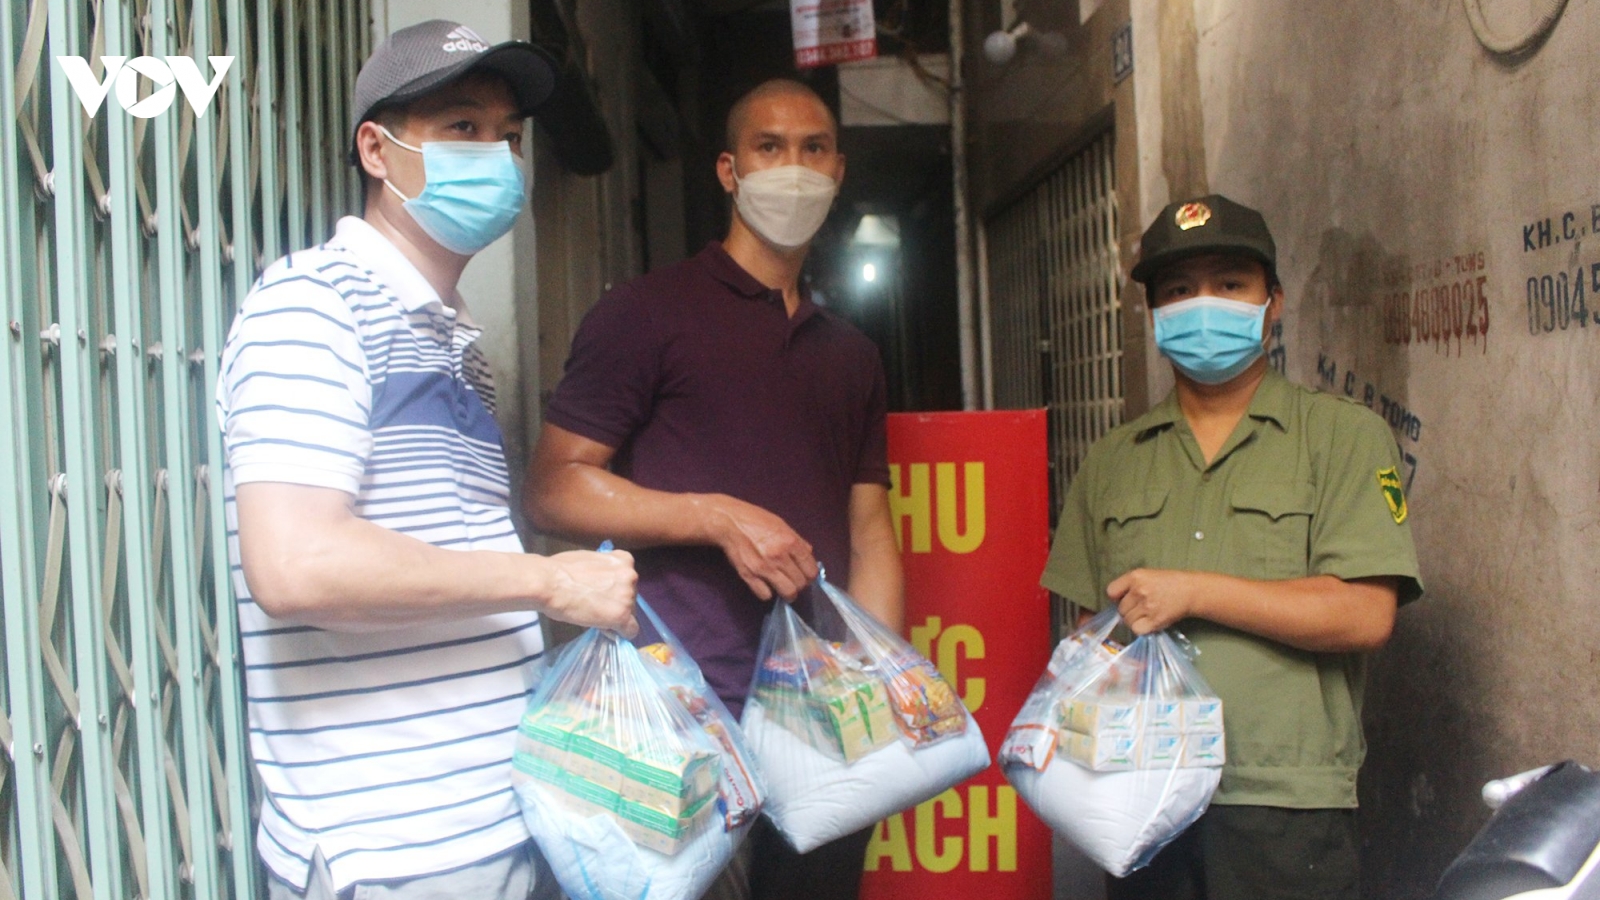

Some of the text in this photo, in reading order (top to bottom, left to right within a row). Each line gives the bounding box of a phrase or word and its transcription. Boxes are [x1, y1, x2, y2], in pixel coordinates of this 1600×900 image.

[442, 38, 489, 53] adid
[888, 461, 986, 554] HU
[864, 785, 1017, 873] ACH
